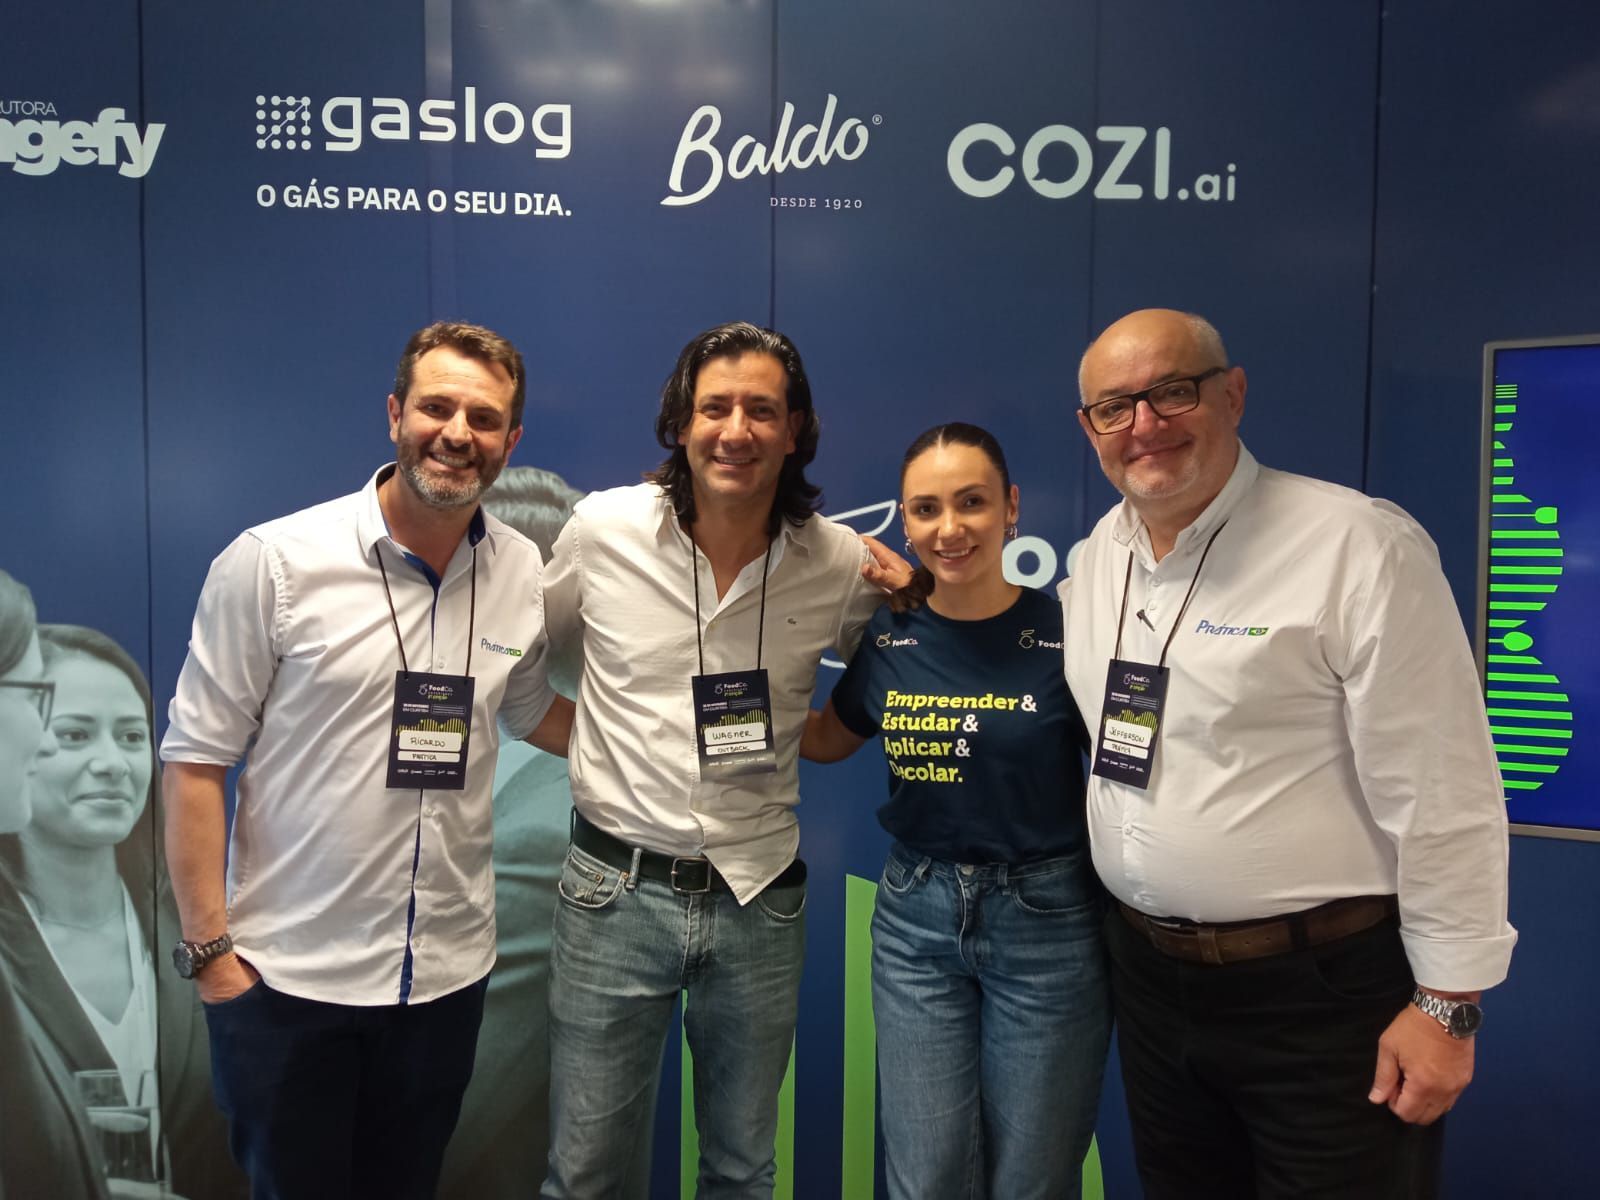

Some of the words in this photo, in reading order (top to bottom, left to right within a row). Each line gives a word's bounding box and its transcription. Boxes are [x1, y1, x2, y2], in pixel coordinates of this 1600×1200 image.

[0, 100, 58, 116] UTORA
[321, 86, 572, 159] gaslog
[660, 93, 869, 206] Baldo
[256, 184, 276, 207] O
[283, 178, 340, 209] GÁS
[347, 187, 422, 211] PARA
[427, 189, 447, 212] O
[454, 190, 507, 214] SEU
[514, 192, 572, 216] DIA.
[770, 197, 817, 208] DESDE
[824, 198, 863, 210] 1920
[885, 690, 1018, 711] Empreender
[881, 711, 960, 732] Estudar
[884, 736, 953, 760] Aplicar
